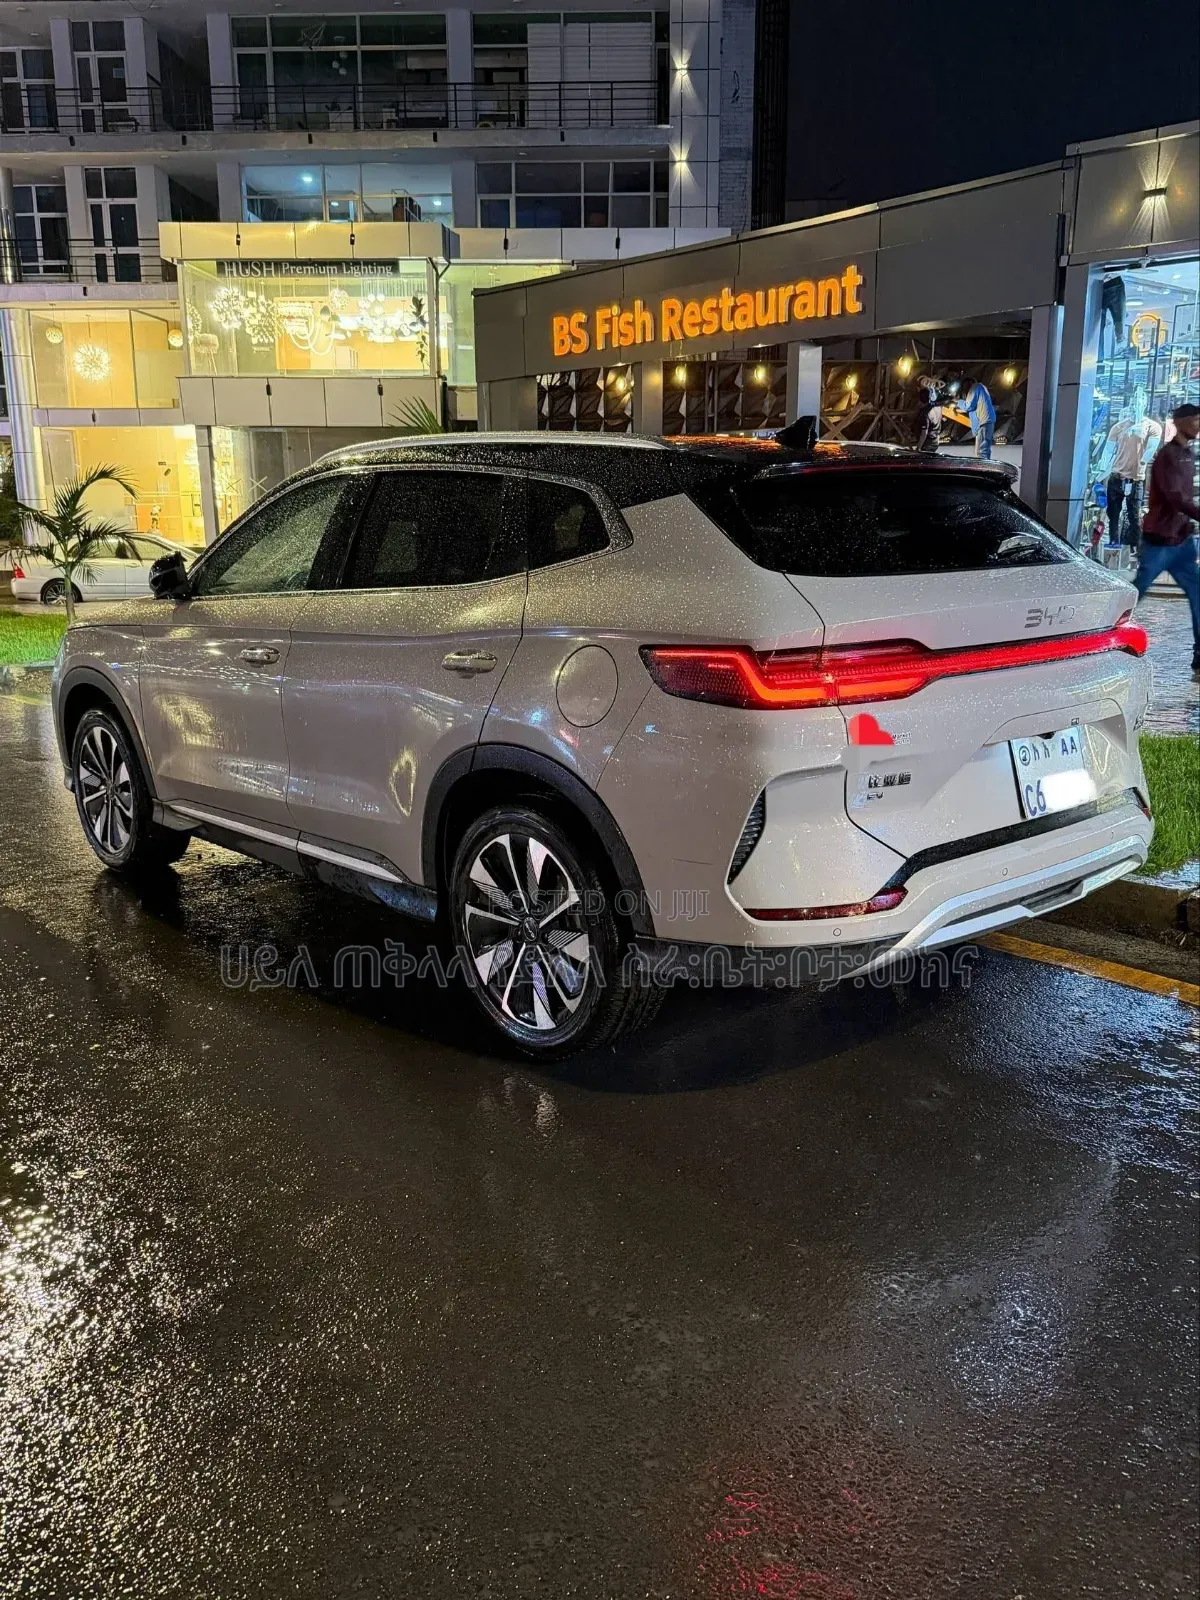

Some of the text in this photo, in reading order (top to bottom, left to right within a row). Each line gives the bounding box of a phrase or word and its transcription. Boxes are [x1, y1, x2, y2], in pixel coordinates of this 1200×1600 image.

[223, 261, 393, 277] HUSH Premium Lighting
[552, 264, 864, 356] BS Fish Restaurant
